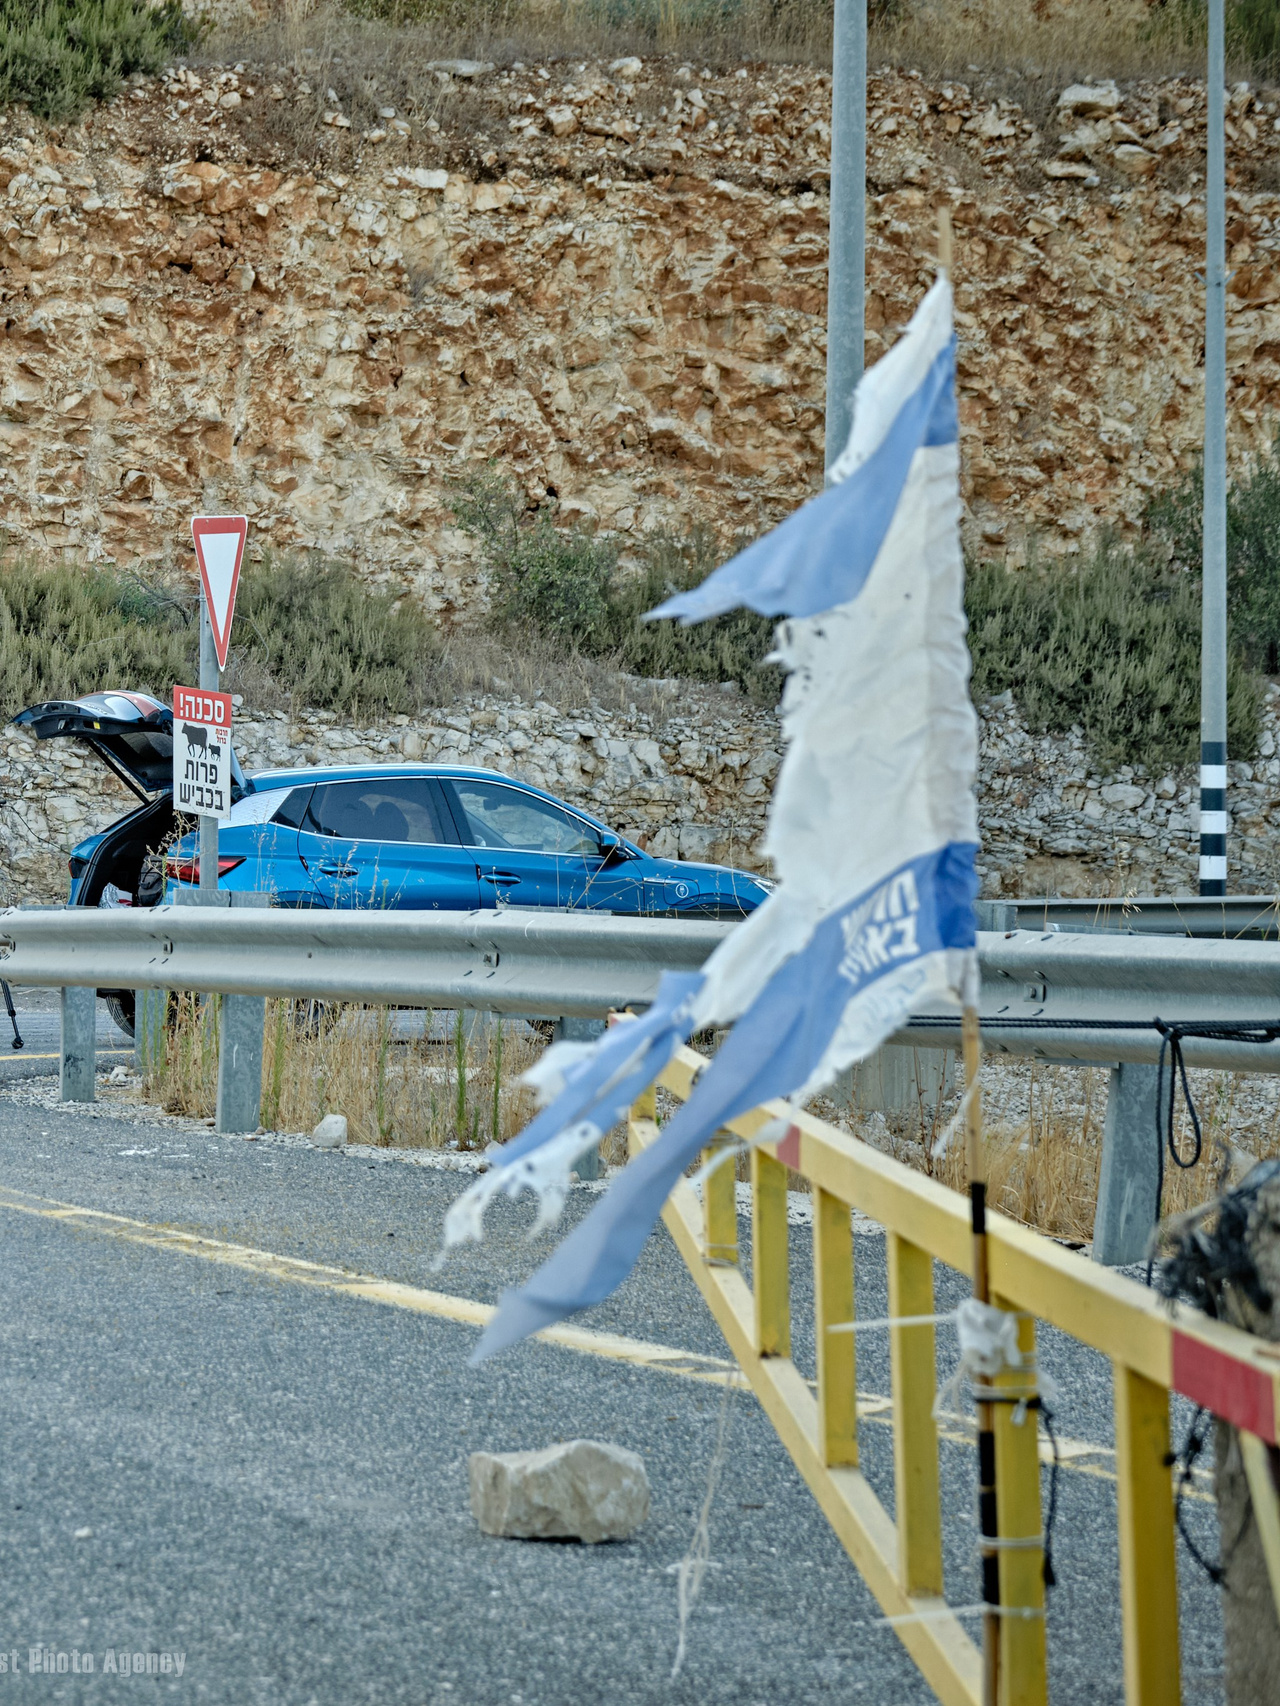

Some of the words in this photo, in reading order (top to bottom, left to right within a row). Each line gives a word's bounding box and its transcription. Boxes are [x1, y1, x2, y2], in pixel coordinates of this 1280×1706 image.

[180, 692, 225, 724] סכנה!
[185, 759, 218, 785] פרות
[180, 782, 224, 811] בכביש
